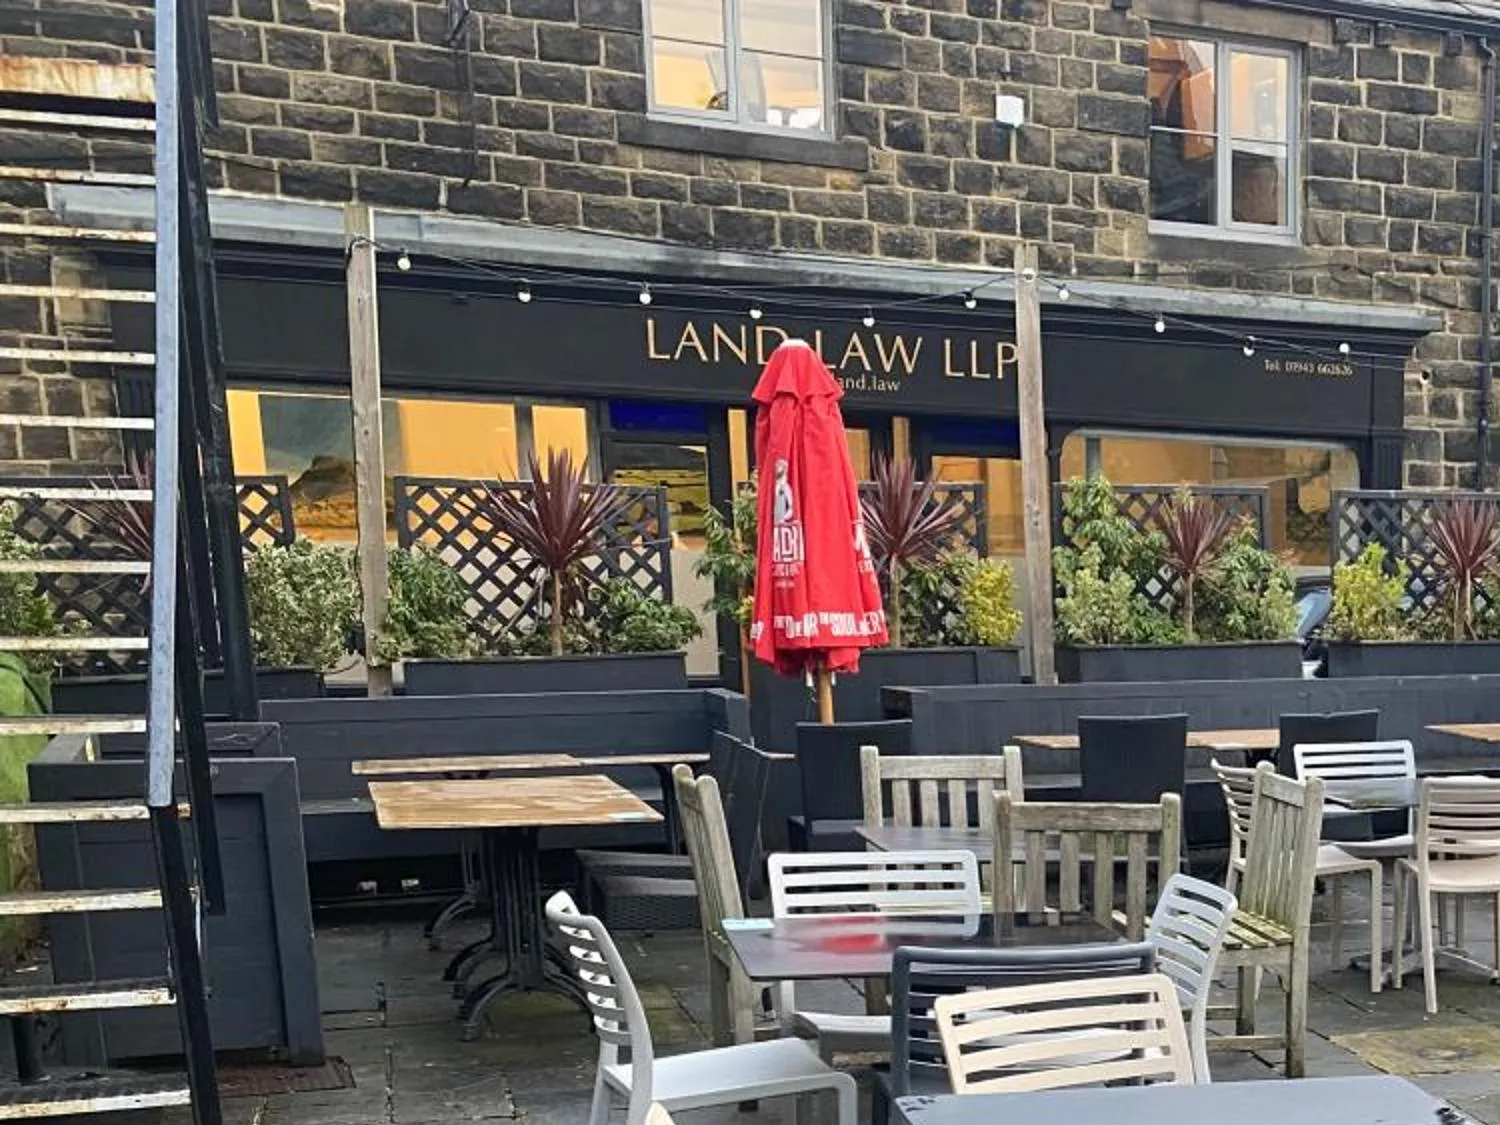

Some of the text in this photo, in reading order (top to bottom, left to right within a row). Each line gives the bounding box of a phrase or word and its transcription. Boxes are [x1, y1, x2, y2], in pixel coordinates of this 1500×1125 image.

[646, 317, 1019, 380] LAND LAW LLP
